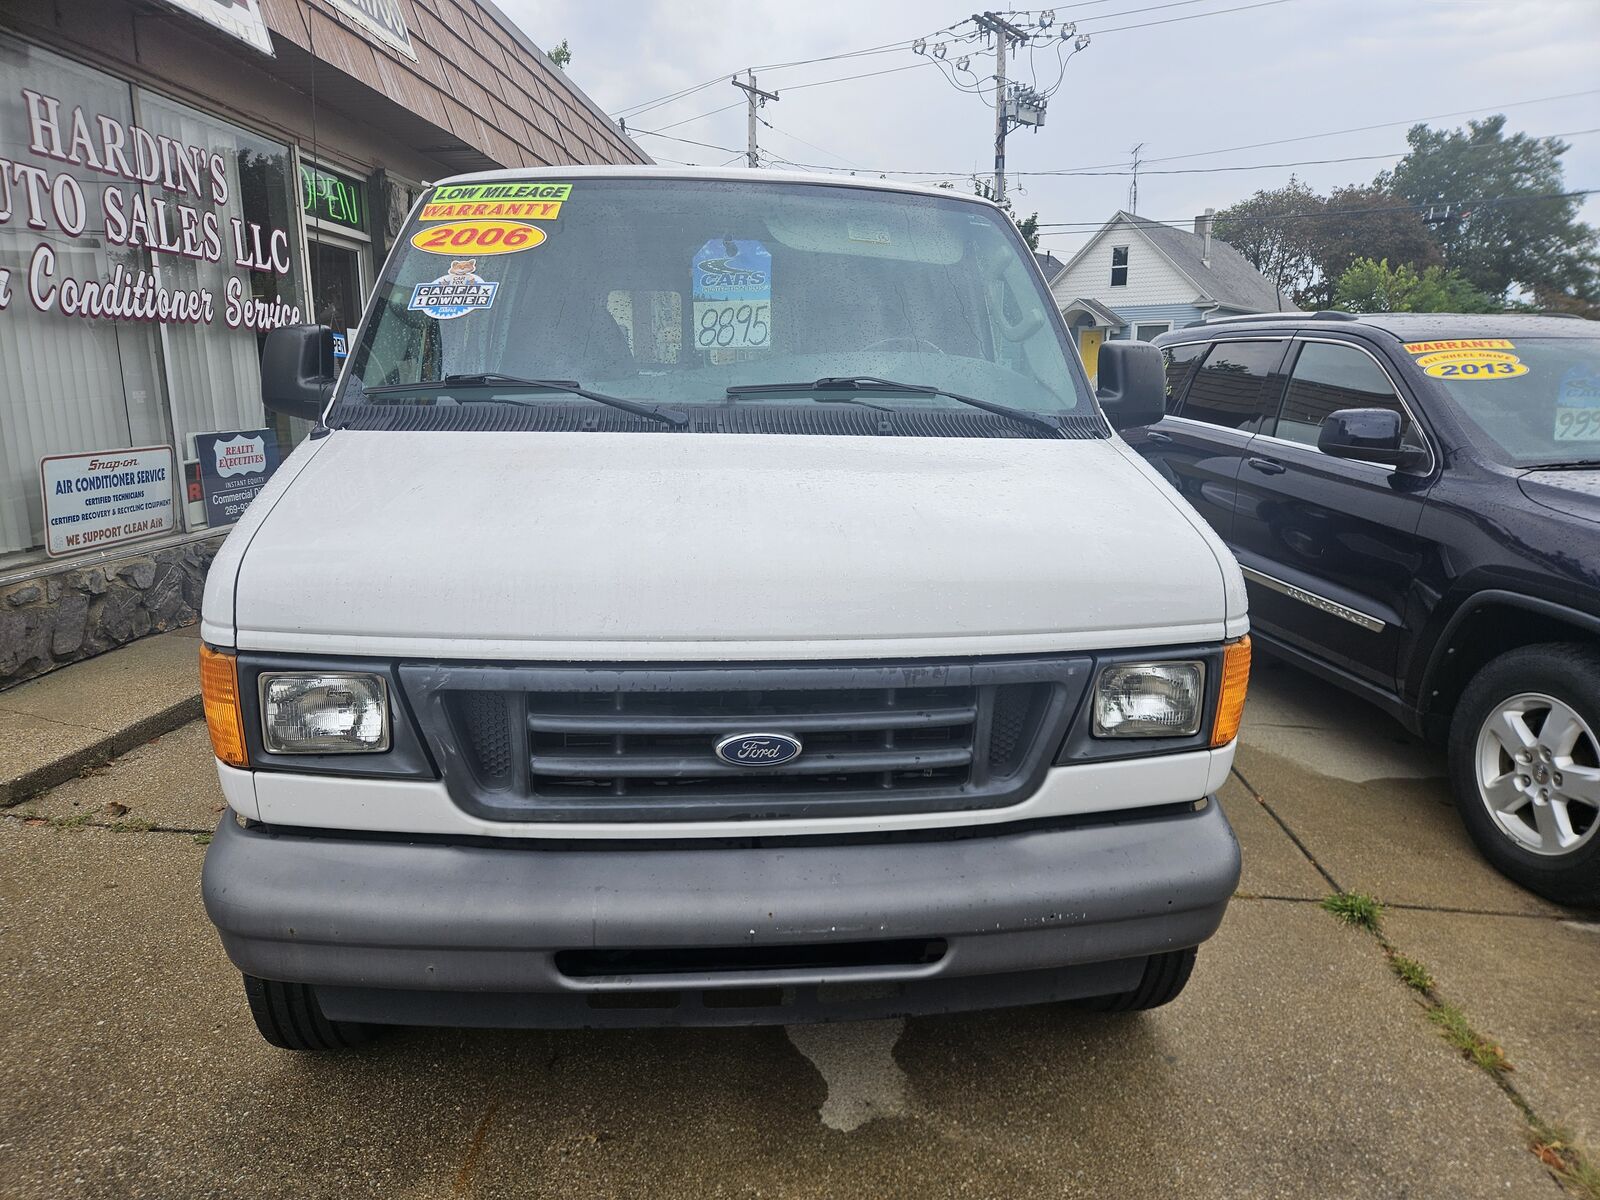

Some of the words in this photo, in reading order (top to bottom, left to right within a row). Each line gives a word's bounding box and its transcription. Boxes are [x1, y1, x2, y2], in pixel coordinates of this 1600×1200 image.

[23, 88, 229, 205] HARDIN'S
[435, 187, 480, 201] LOW
[480, 186, 568, 200] MILEAGE
[422, 203, 554, 218] WARRANTY
[104, 186, 222, 263] SALES
[231, 217, 290, 274] LLC
[421, 227, 533, 248] 2006
[28, 243, 214, 323] Conditioner
[225, 277, 302, 330] Service
[700, 271, 766, 287] CARS
[419, 286, 490, 295] CARFAX
[417, 297, 424, 305] 1
[428, 296, 488, 305] OWNER
[698, 305, 768, 346] 8895
[1407, 339, 1508, 353] WARRANTY
[1423, 355, 1440, 365] ALL
[1441, 352, 1476, 360] WHEEL
[1477, 352, 1513, 361] DRIVE
[1440, 362, 1517, 376] 2013
[225, 444, 255, 456] REALTY
[88, 458, 138, 472] Snap-on
[218, 454, 264, 470] EXECUTIVES
[55, 478, 74, 496] AIR
[75, 472, 135, 492] CONDITIONER
[137, 467, 166, 484] SERVICE
[225, 480, 247, 489] INSTANT
[247, 476, 265, 486] EQUITY
[85, 495, 112, 506] CERTIFIED
[113, 490, 145, 502] TECHNICIANS
[212, 490, 253, 505] Commercial
[50, 513, 81, 526] CERTIFIED
[81, 509, 110, 521] RECOVERY
[117, 503, 145, 515] RECYCLING
[145, 498, 172, 510] EQUIPMENT
[66, 533, 81, 546] WE
[82, 526, 122, 544] SUPPORT
[123, 520, 149, 535] CLEAN
[738, 741, 781, 758] Ford
